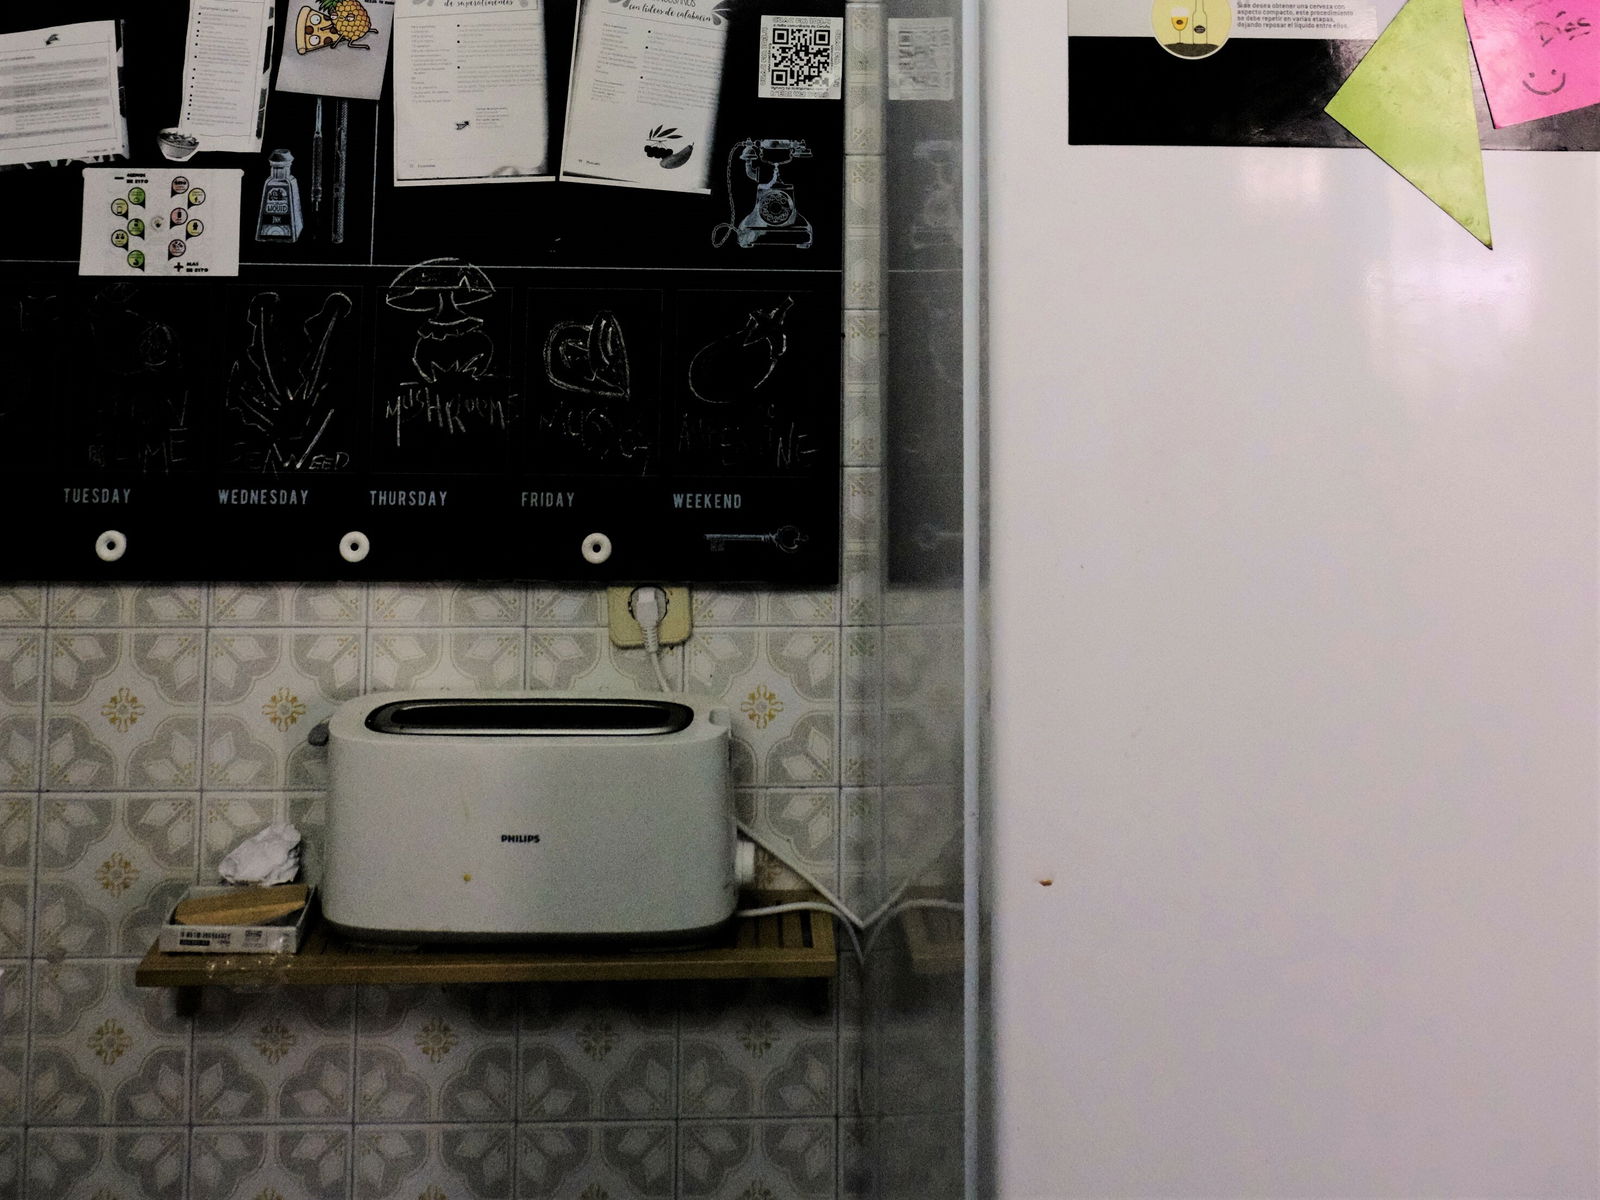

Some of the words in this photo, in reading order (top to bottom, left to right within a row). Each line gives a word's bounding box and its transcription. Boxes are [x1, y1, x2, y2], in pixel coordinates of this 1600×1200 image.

[63, 488, 131, 504] TUESDAY
[218, 489, 309, 505] WEDNESDAY
[369, 490, 448, 506] THURSDAY
[520, 492, 576, 508] FRIDAY
[673, 493, 742, 509] WEEKEND
[501, 835, 540, 843] PHILIPS
